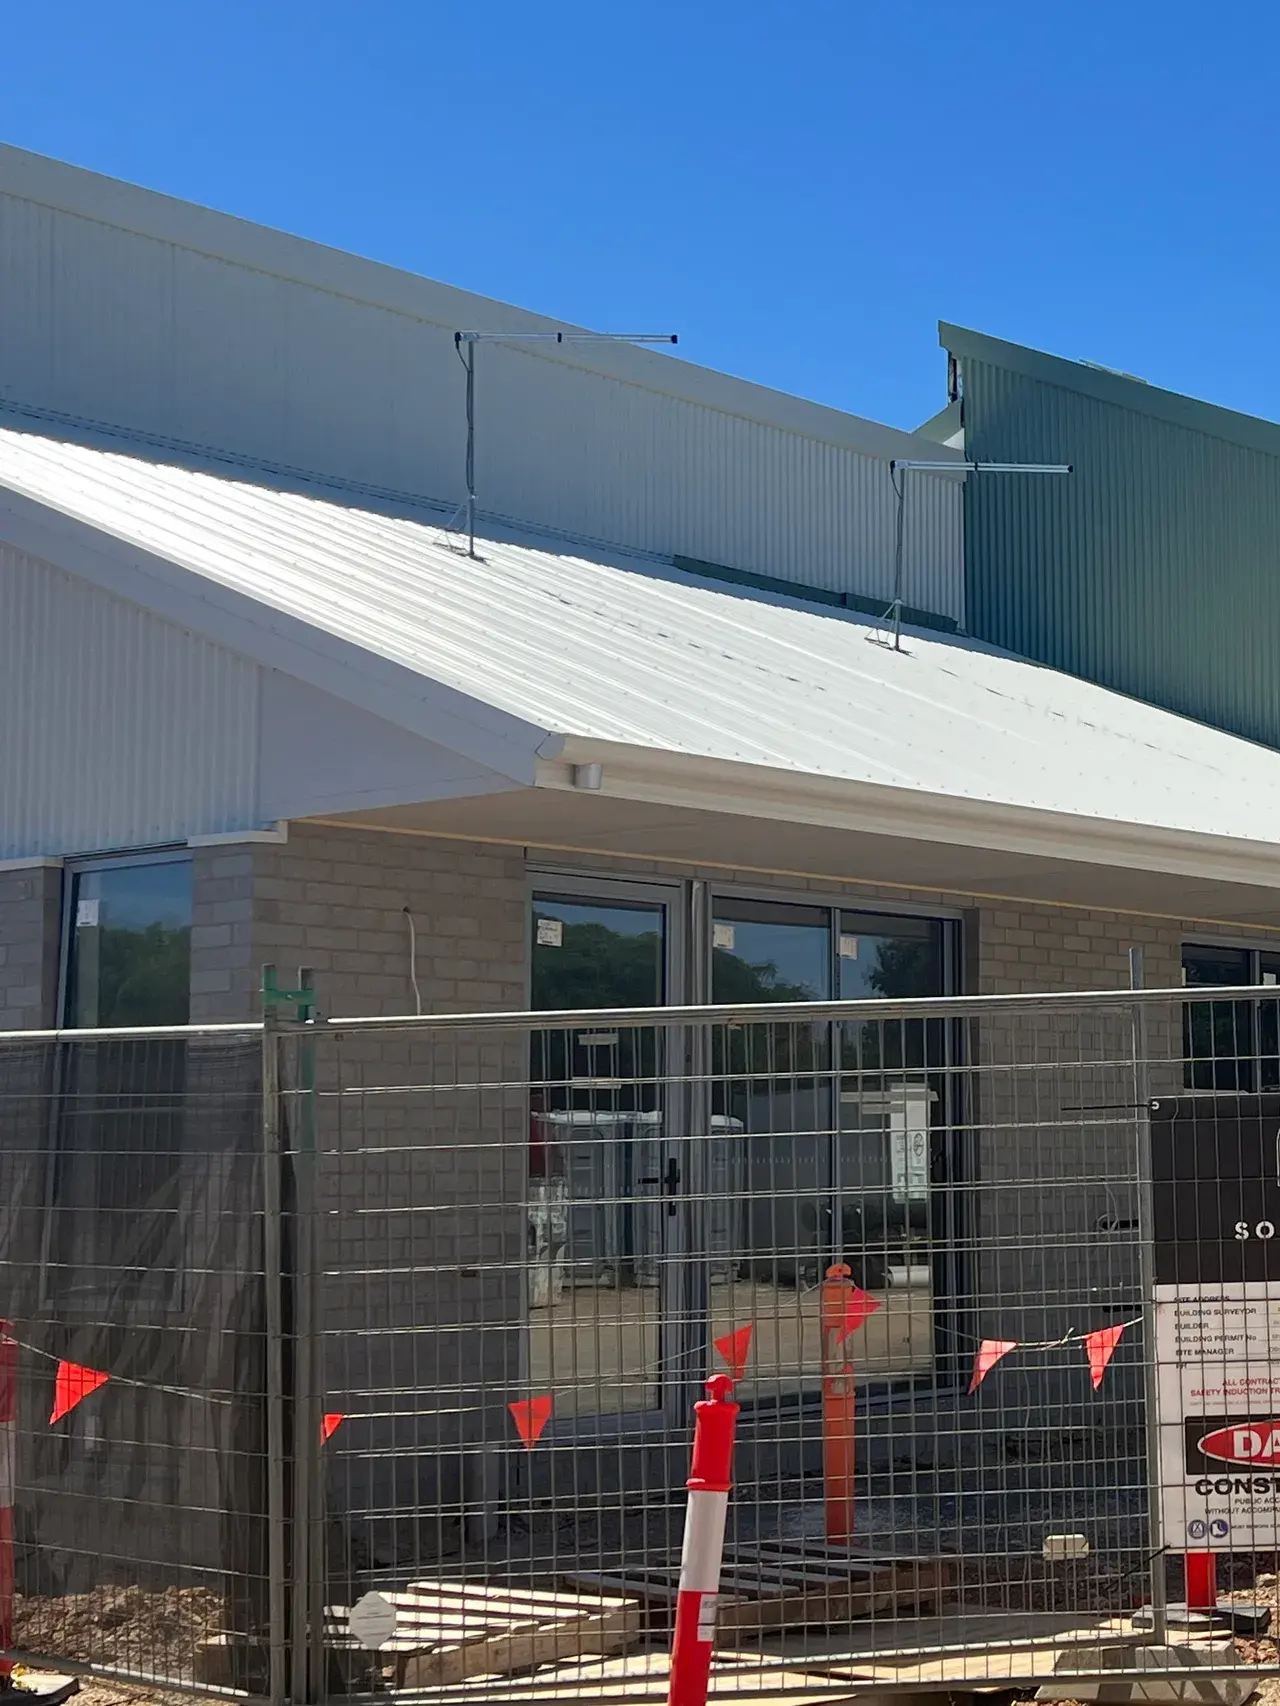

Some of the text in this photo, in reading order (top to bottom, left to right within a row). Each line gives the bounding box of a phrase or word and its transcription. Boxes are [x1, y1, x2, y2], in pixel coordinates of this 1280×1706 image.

[1174, 1309, 1211, 1317] BUILDING
[1190, 1388, 1221, 1396] SAFETY
[1223, 1387, 1268, 1396] INDUCTION
[1204, 1507, 1240, 1515] WITHOUT
